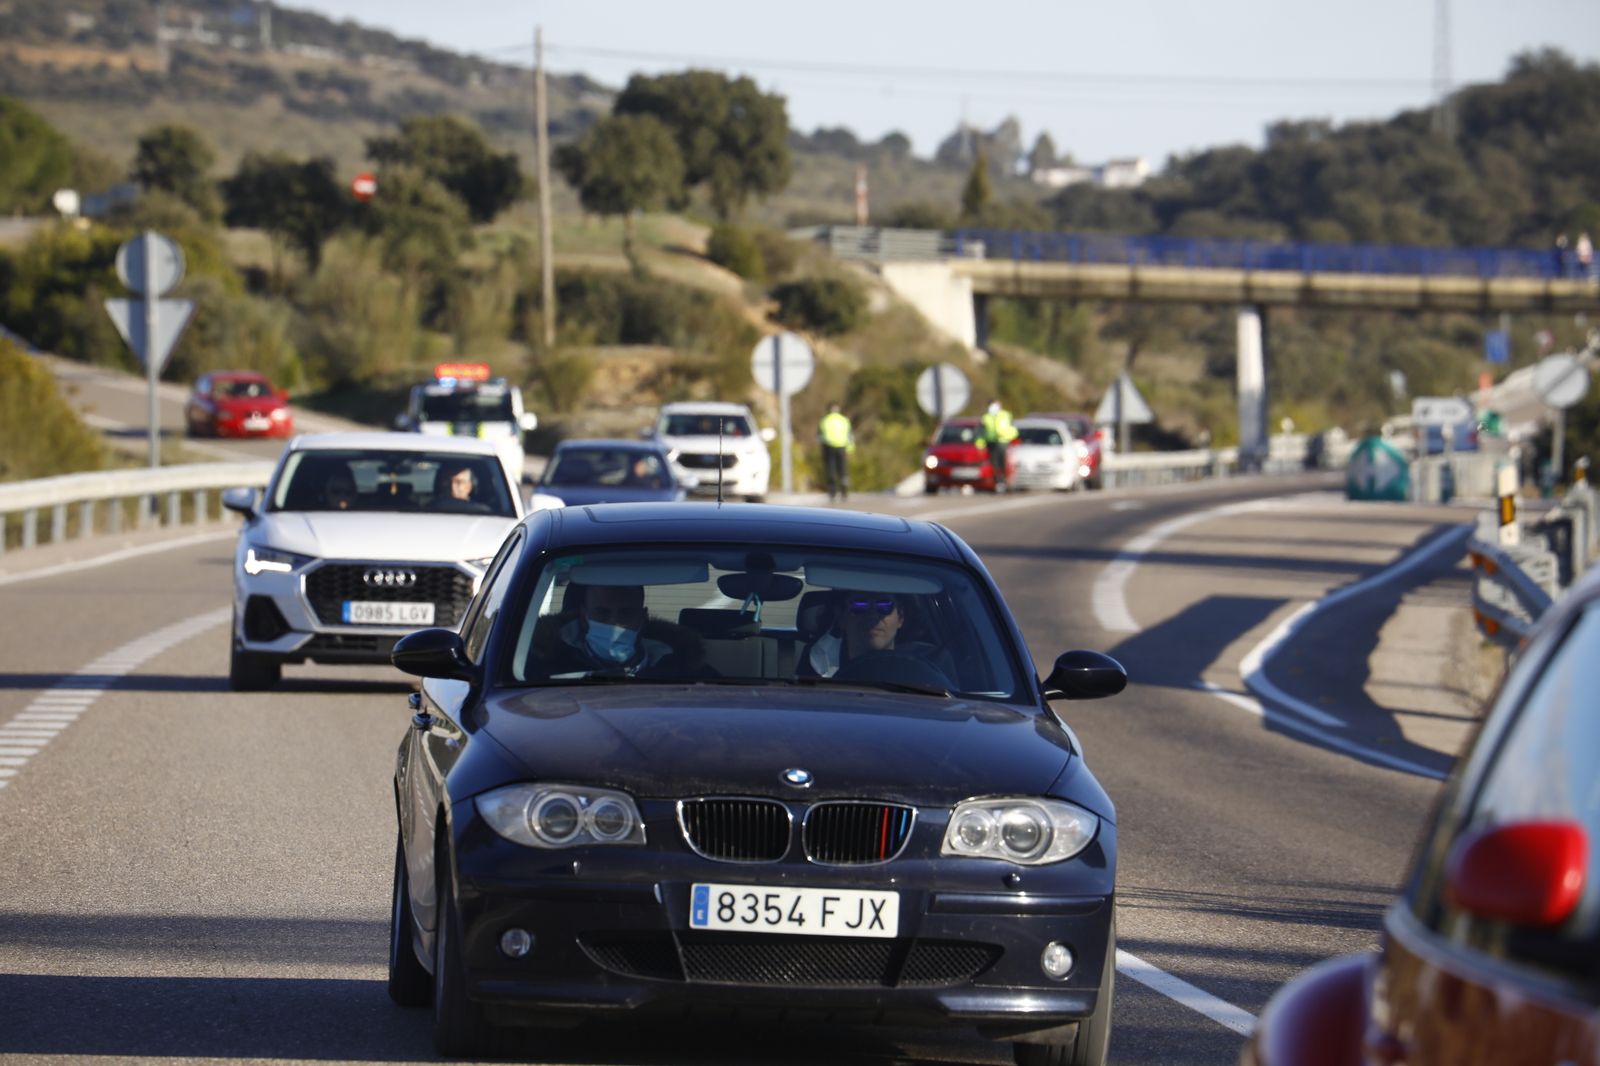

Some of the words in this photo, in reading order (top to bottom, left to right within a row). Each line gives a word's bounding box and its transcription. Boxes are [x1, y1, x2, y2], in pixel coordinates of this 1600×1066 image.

[354, 604, 394, 620] 0985
[717, 892, 806, 927] 8354
[820, 896, 886, 930] FJX
